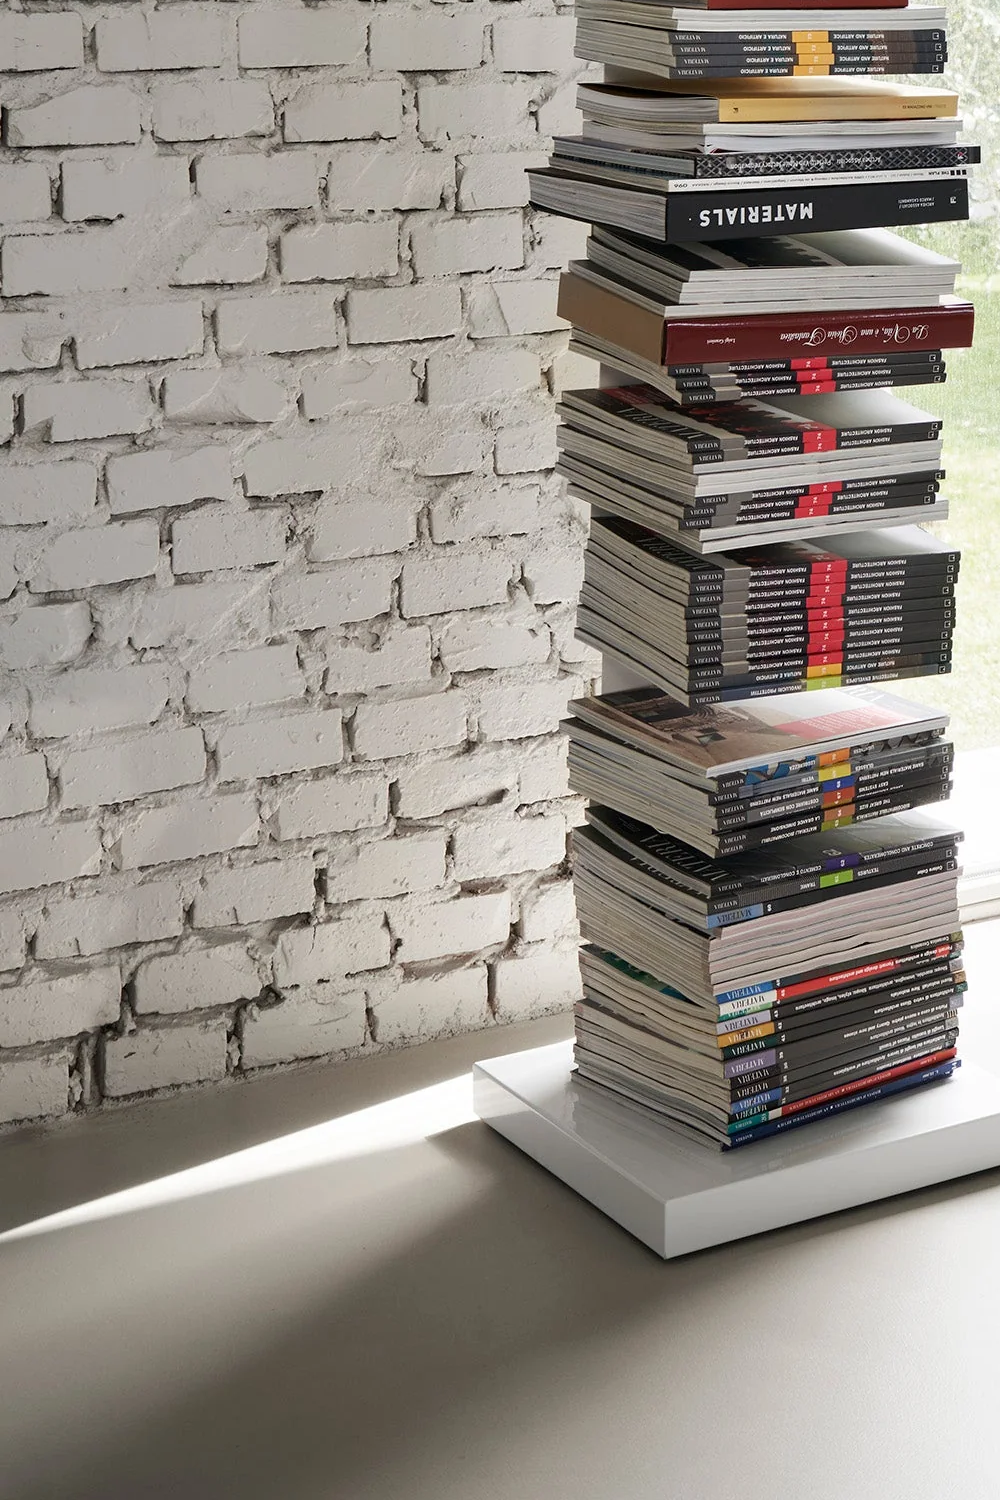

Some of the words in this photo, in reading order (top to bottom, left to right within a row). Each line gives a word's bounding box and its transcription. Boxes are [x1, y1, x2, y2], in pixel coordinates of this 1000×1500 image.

[699, 202, 813, 227] MATERIALS
[780, 327, 826, 346] Fantastica
[827, 325, 857, 345] Storia
[913, 324, 928, 340] La
[841, 429, 872, 437] ARCHITECTURE
[744, 438, 778, 446] ARCHITECTURE
[852, 561, 886, 569] ARCHITECTURE
[750, 568, 786, 576] ARCHITECTURE
[756, 674, 779, 682] ARTIFICIO
[750, 688, 777, 696] PROTETTIVI
[889, 764, 912, 774] MATERIALS
[912, 761, 924, 769] SAME
[858, 772, 879, 781] PATTERNS
[806, 786, 819, 794] SAME
[858, 784, 878, 793] SYSTEMS
[782, 789, 806, 799] MATERIALS
[749, 798, 771, 808] PATTERNS
[785, 802, 795, 810] CON
[796, 797, 819, 808] COSTRUIRE
[770, 820, 797, 833] DIMENSIONE
[797, 817, 814, 826] GRANDE
[911, 841, 933, 850] CONCRETE
[799, 865, 821, 875] CEMENTO
[857, 867, 879, 877] TEXTURES
[760, 870, 795, 883] CONGLOMERATI
[716, 908, 752, 924] MATERIA
[726, 985, 761, 999] MATERIA
[731, 995, 765, 1010] MATERIA
[724, 1016, 759, 1030] MATERIA
[728, 1027, 762, 1043] MATERIA
[731, 1040, 766, 1055] MATERIA
[731, 1058, 764, 1073] MATERIA
[737, 1068, 770, 1084] MATERIA
[737, 1082, 768, 1098] MATERIA
[739, 1093, 771, 1109] MATERIA
[735, 1104, 767, 1120] MATERIA
